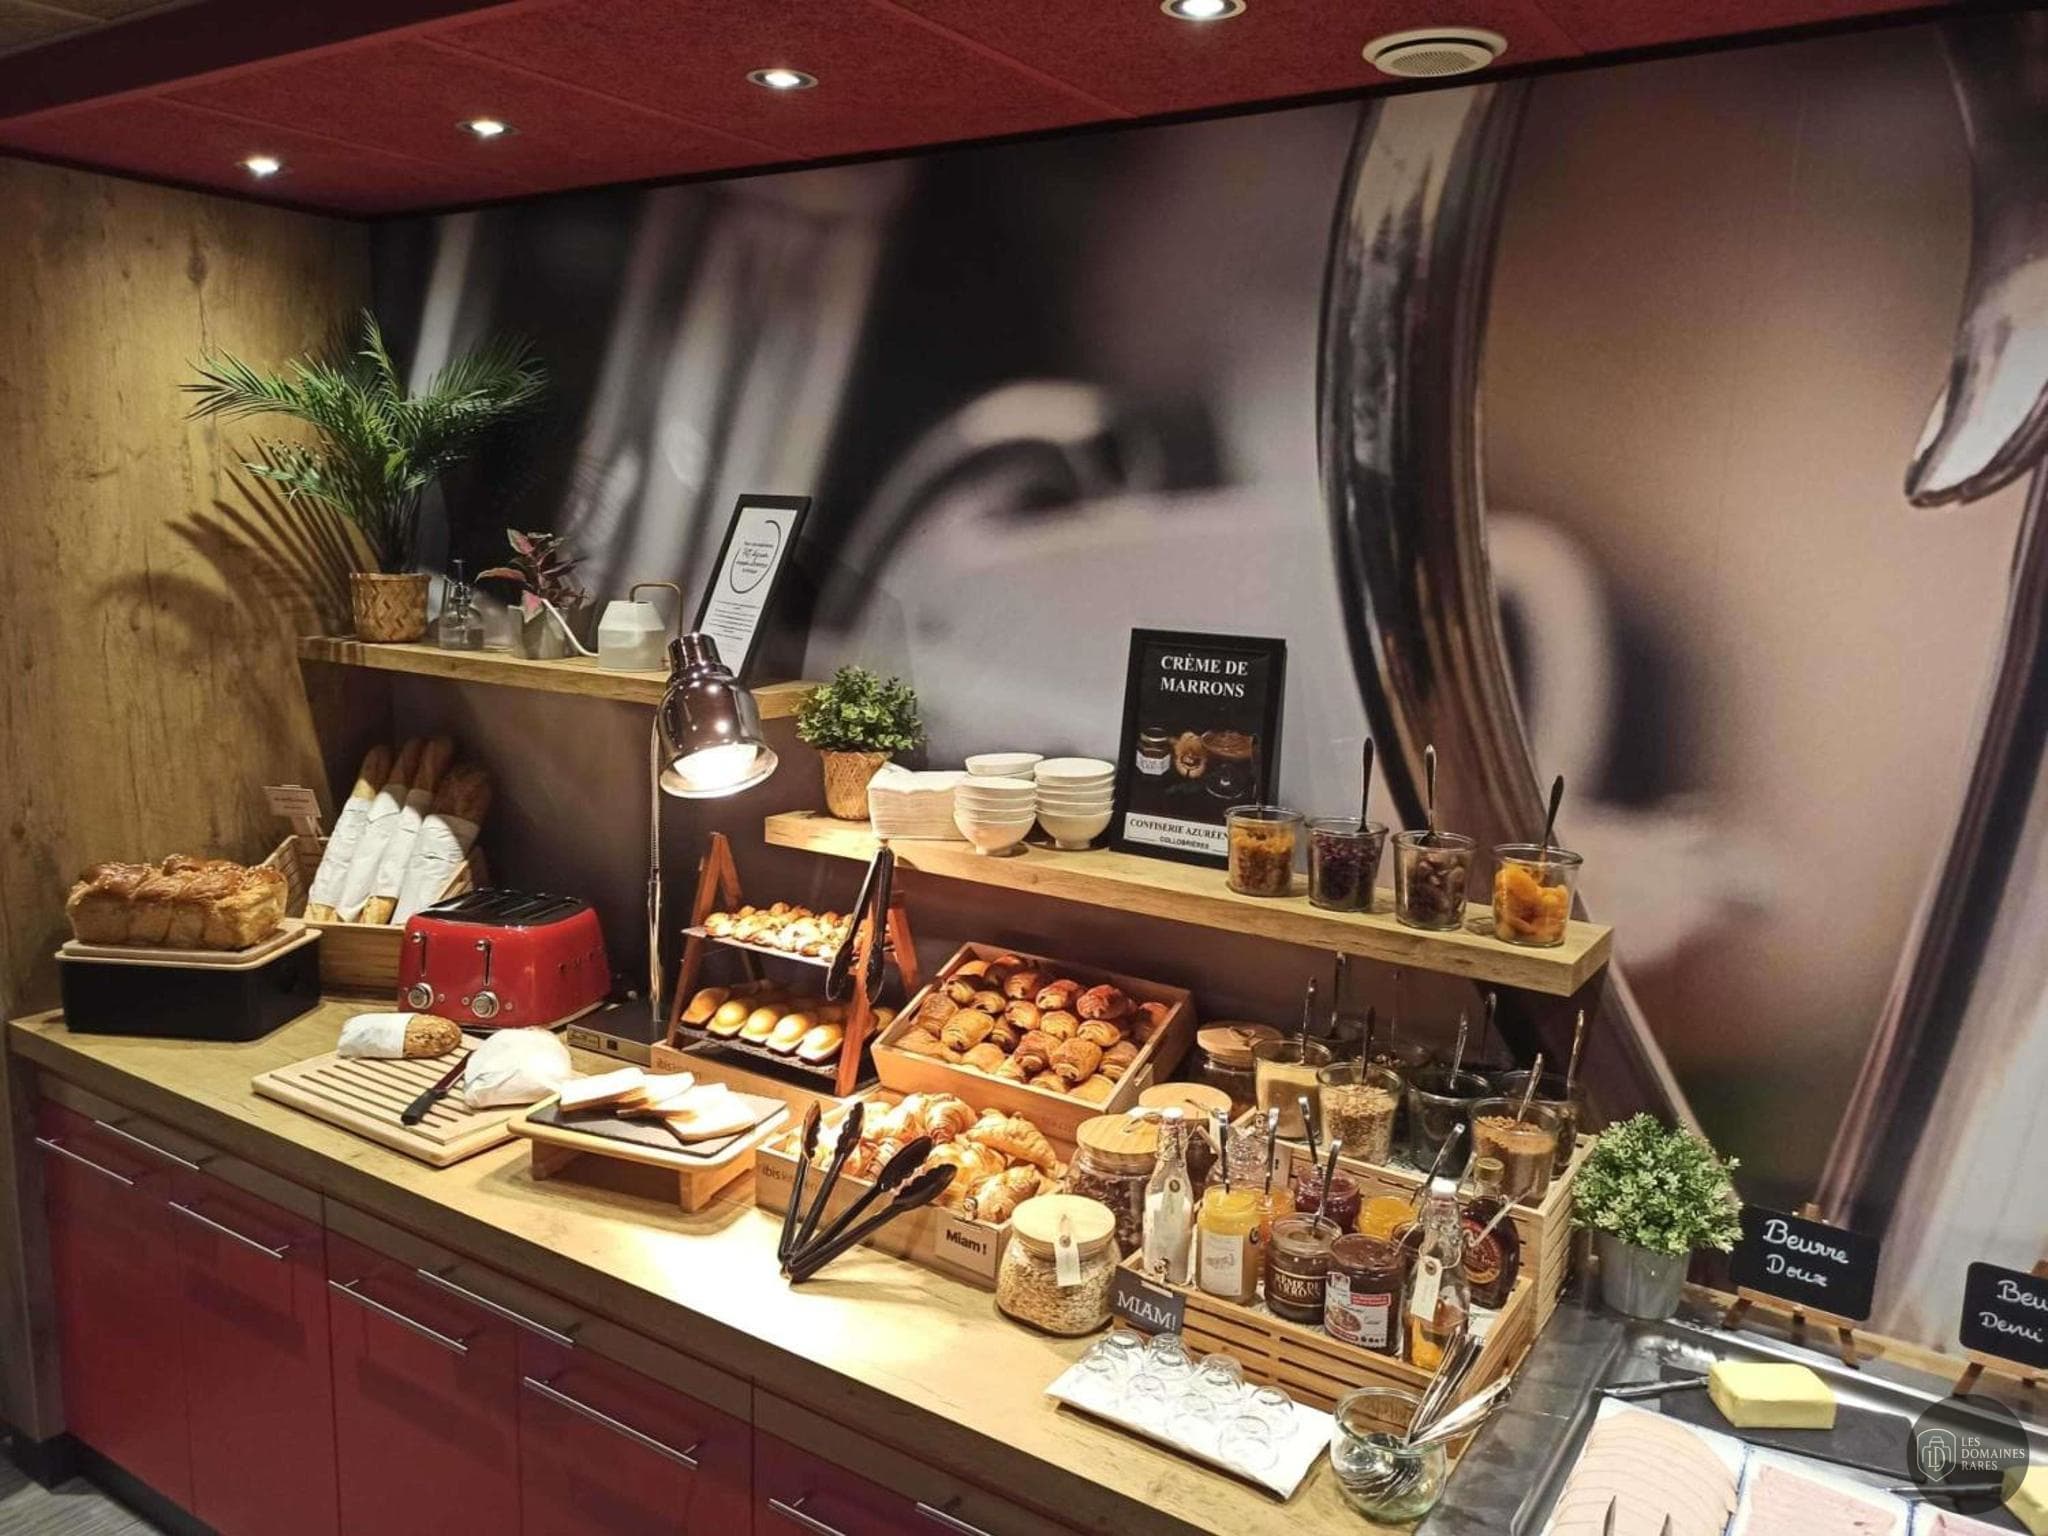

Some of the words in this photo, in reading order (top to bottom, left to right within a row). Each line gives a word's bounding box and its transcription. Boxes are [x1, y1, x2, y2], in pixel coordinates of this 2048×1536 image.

[1160, 653, 1222, 674] CRÈME
[1225, 660, 1249, 676] DE
[1160, 677, 1245, 698] MARRONS
[1130, 818, 1184, 834] CONFISERIE
[1762, 1219, 1850, 1264] Beurre
[1765, 1254, 1828, 1287] Doux
[1117, 1290, 1177, 1331] MIAM!
[1979, 1311, 2043, 1343] Demi
